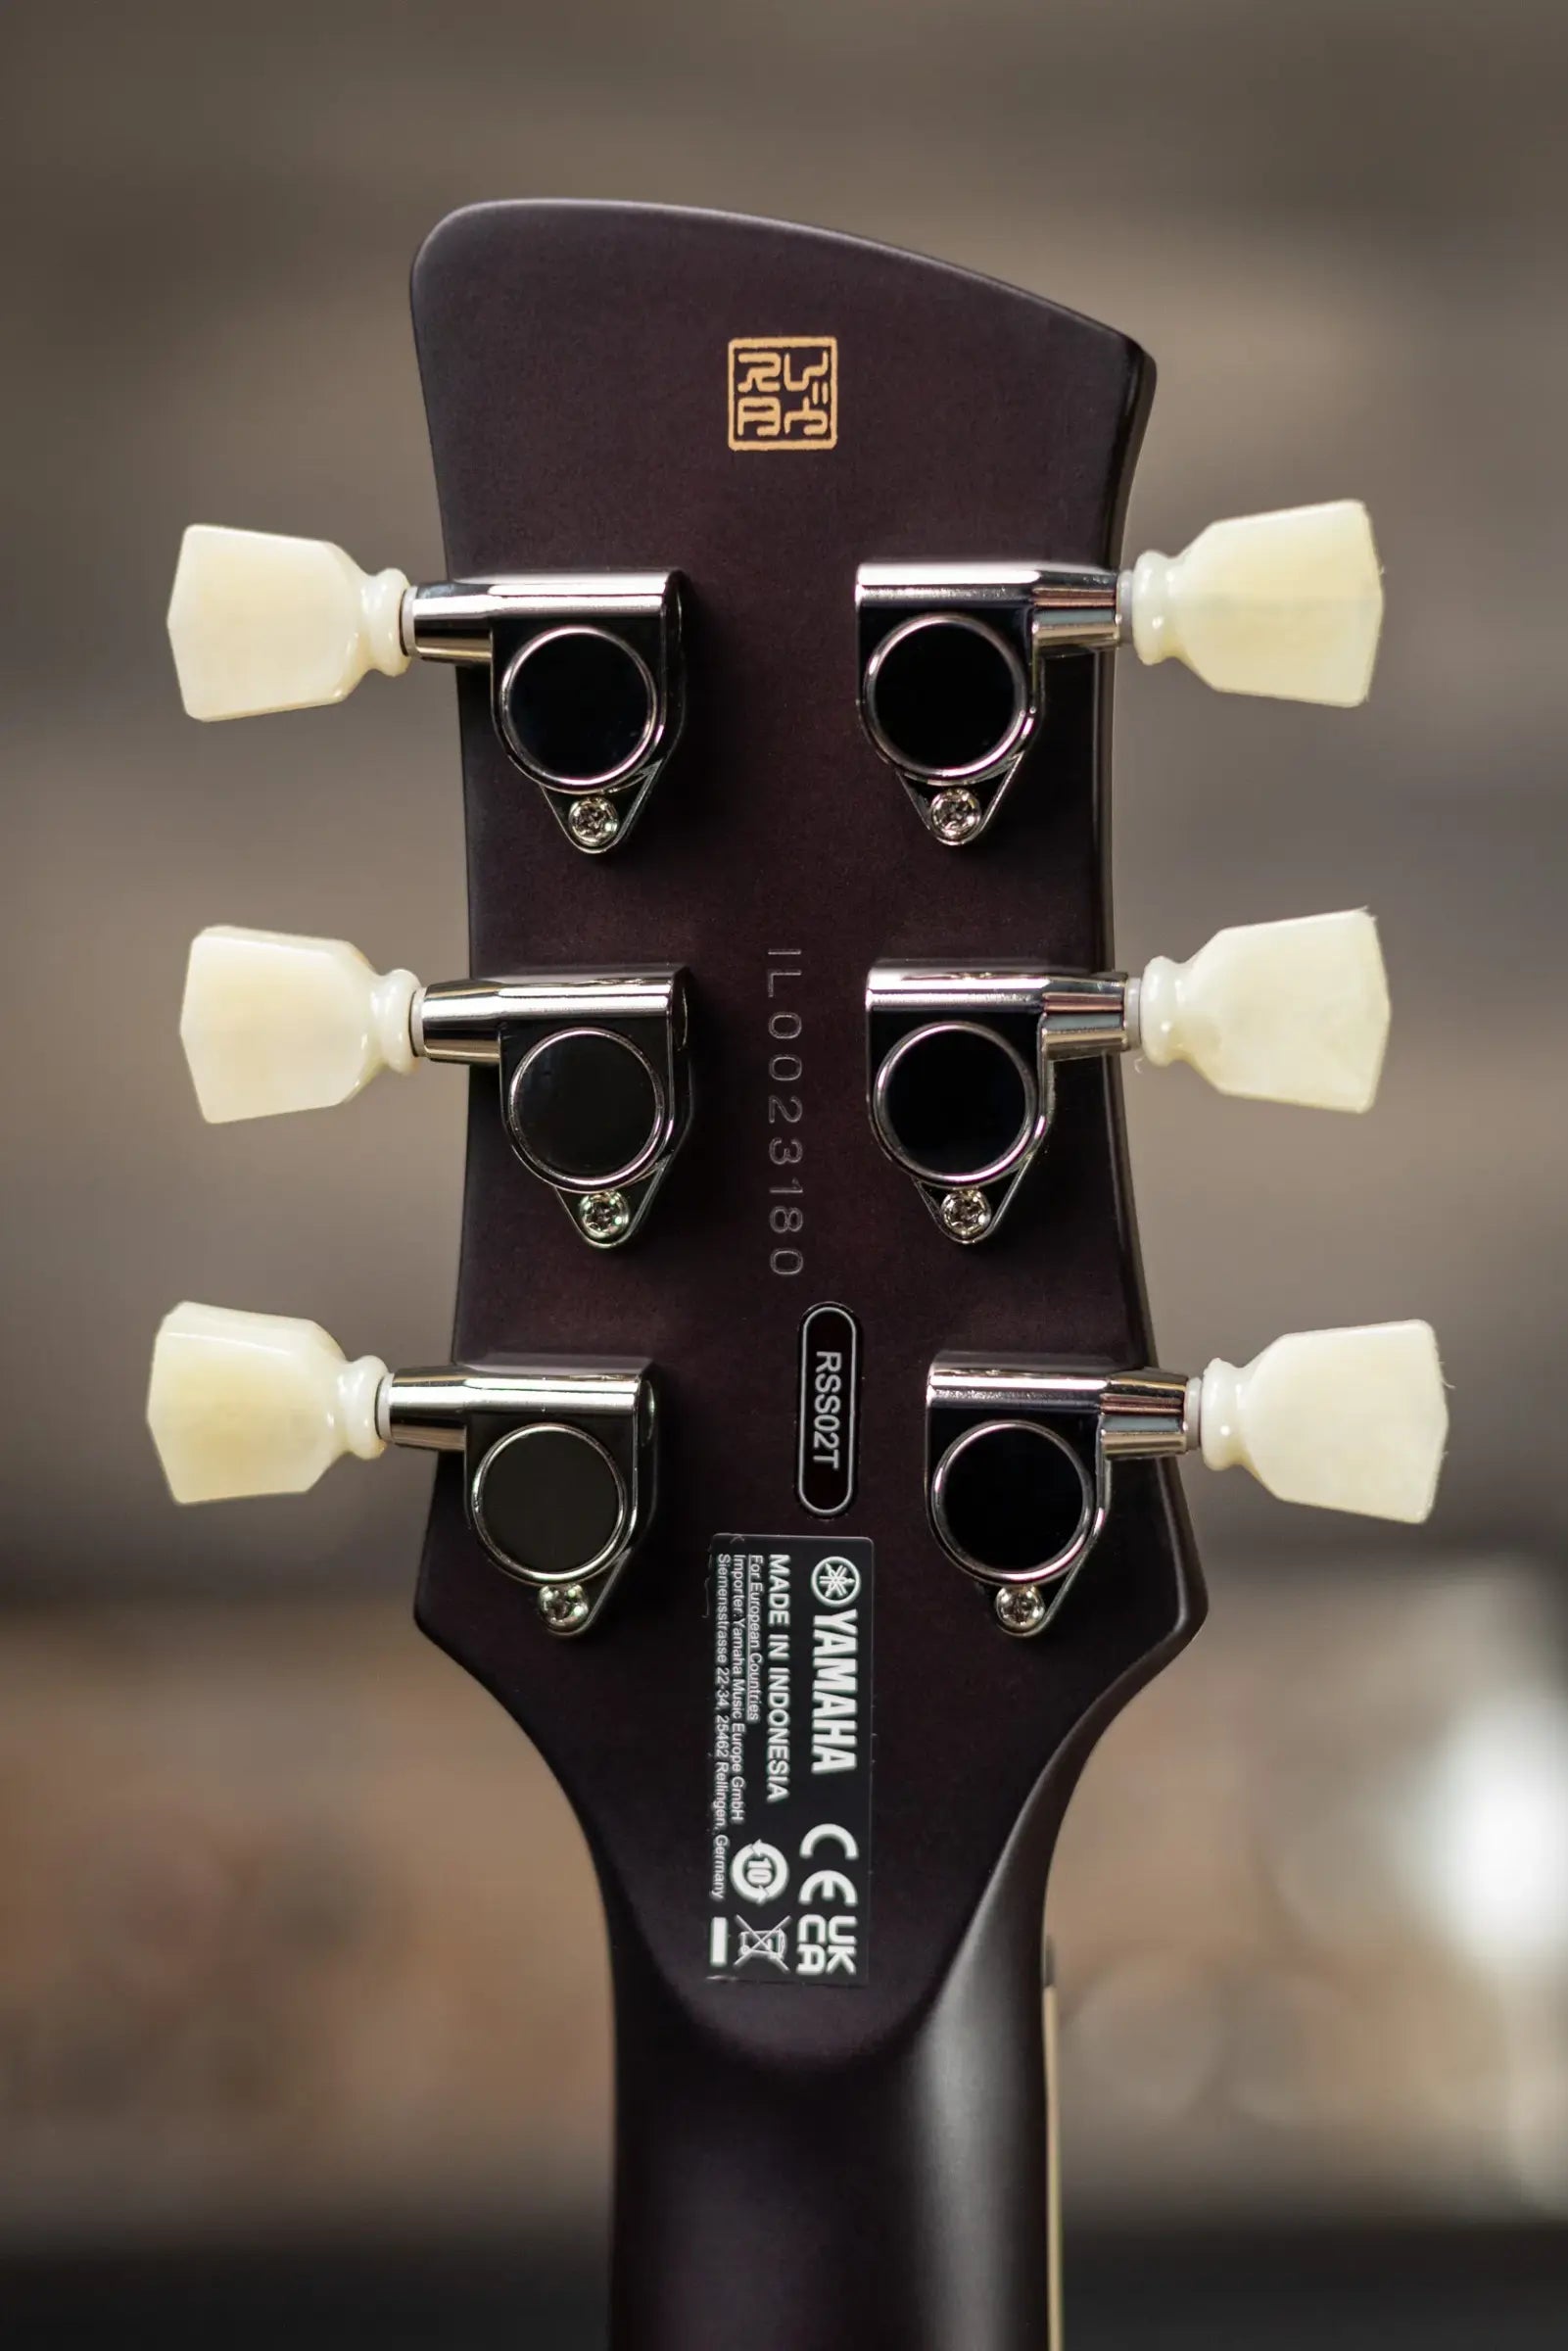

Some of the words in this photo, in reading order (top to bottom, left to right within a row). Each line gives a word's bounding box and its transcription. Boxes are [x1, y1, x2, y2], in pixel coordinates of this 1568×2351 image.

[768, 948, 803, 1275] IL0023180
[813, 1351, 841, 1469] RSS02T
[747, 1555, 764, 1581] For
[768, 1554, 790, 1626] MADE
[716, 1554, 731, 1663] Siemensstrasse
[746, 1584, 764, 1649] European
[768, 1634, 789, 1660] IN
[715, 1667, 730, 1710] 22-34,
[732, 1679, 745, 1718] Music
[747, 1652, 764, 1721] Countries
[811, 1608, 858, 1774] YAMAHA
[716, 1716, 730, 1757] 25462
[729, 1723, 745, 1773] Europe
[766, 1667, 790, 1802] INDONESIA
[712, 1761, 729, 1831] Rellingen,
[731, 1776, 744, 1822] GmbH
[710, 1834, 729, 1898] Germany
[746, 1858, 772, 1885] 10
[798, 1823, 858, 1906] CE
